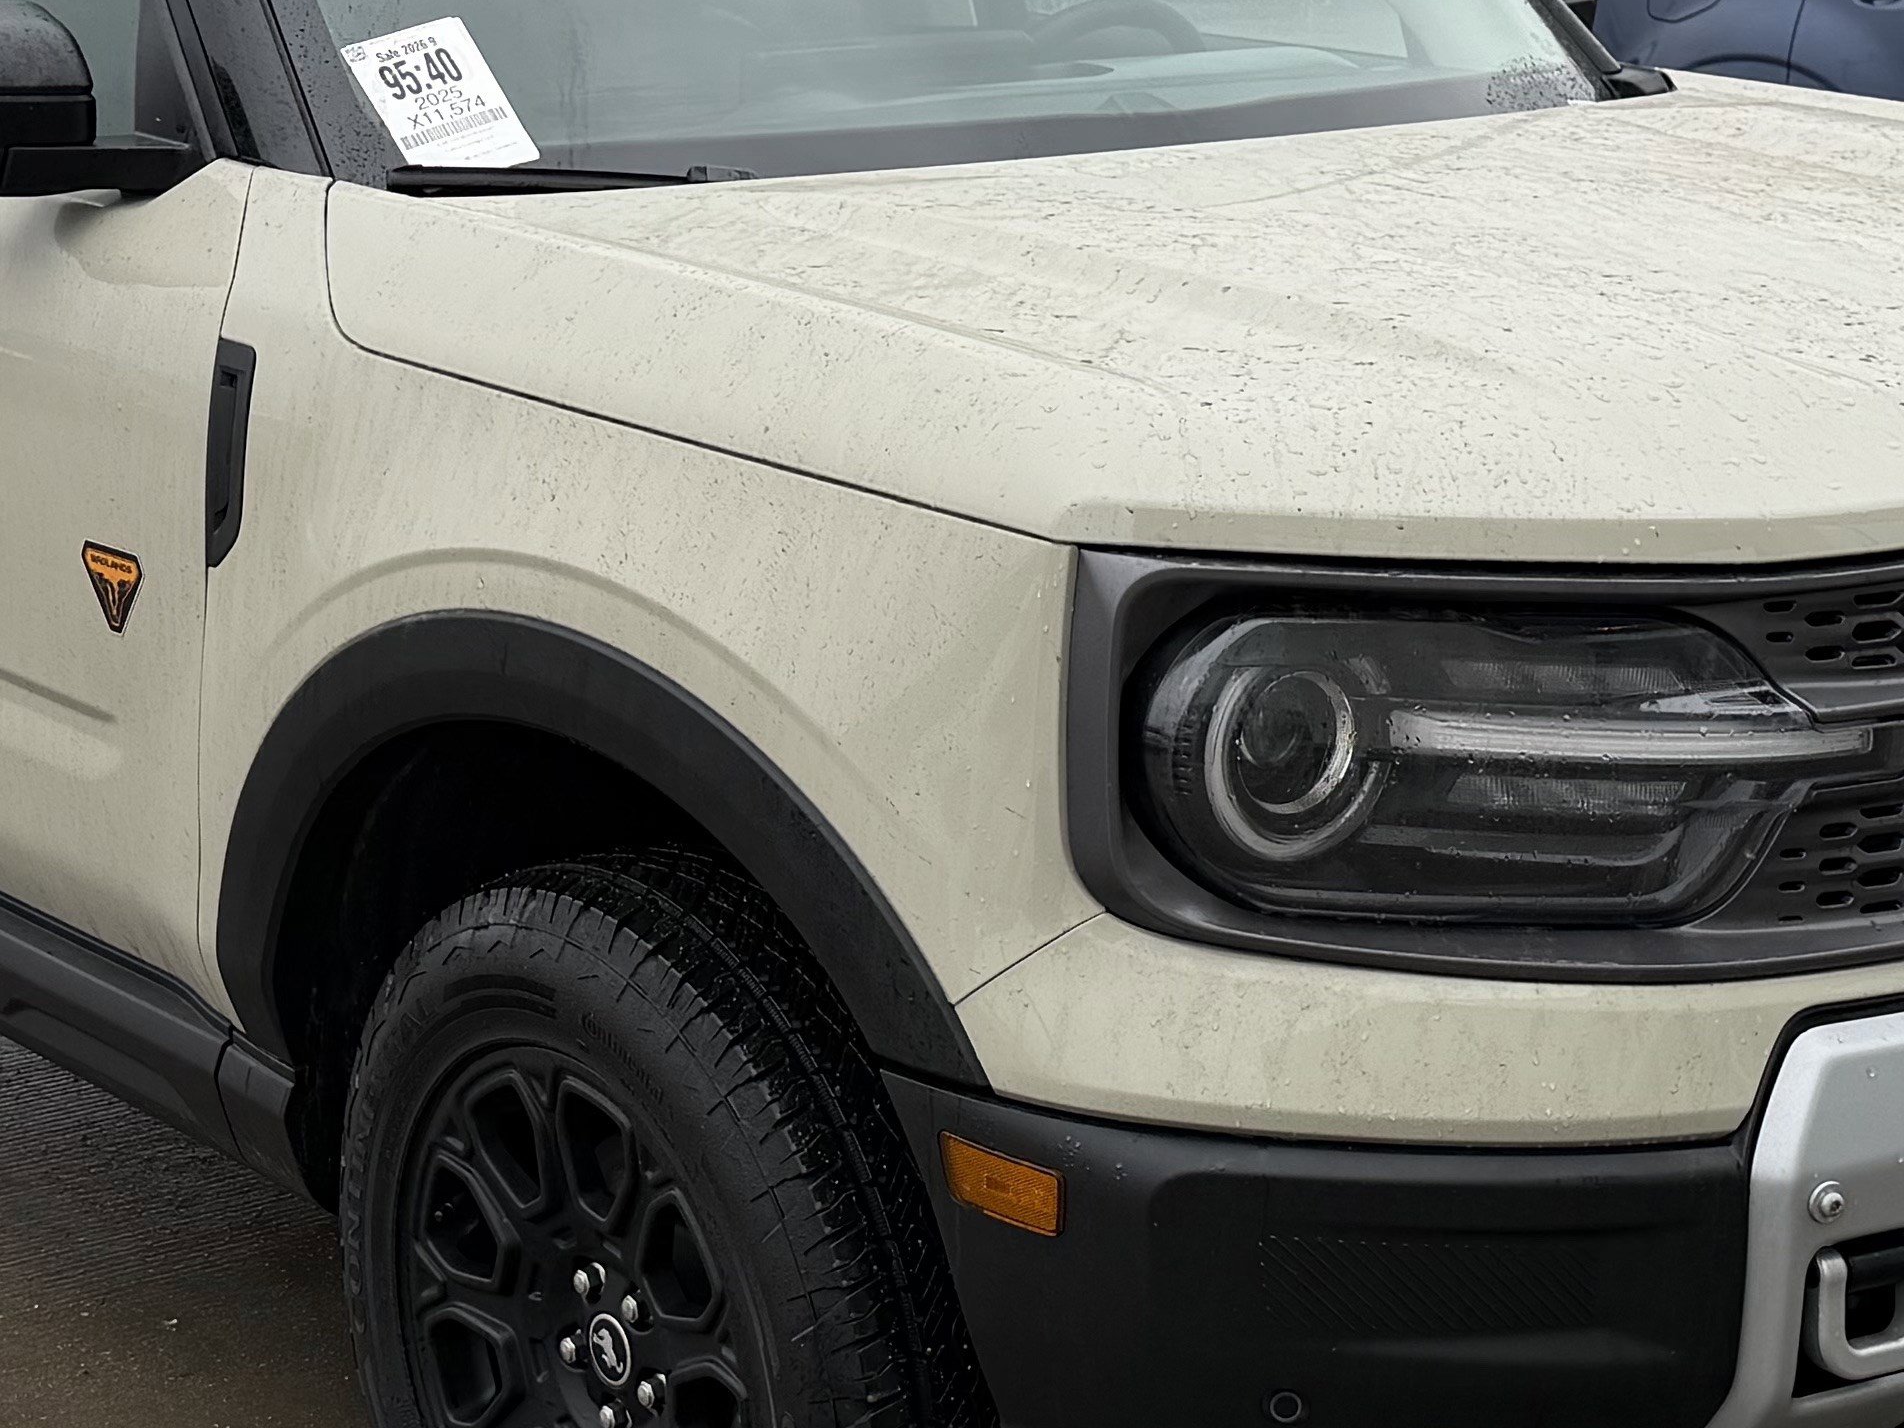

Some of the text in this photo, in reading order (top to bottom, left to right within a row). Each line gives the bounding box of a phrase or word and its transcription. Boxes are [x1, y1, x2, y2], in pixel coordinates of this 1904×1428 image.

[375, 49, 401, 63] Sale
[378, 47, 463, 100] 95:40
[414, 85, 463, 110] 2025
